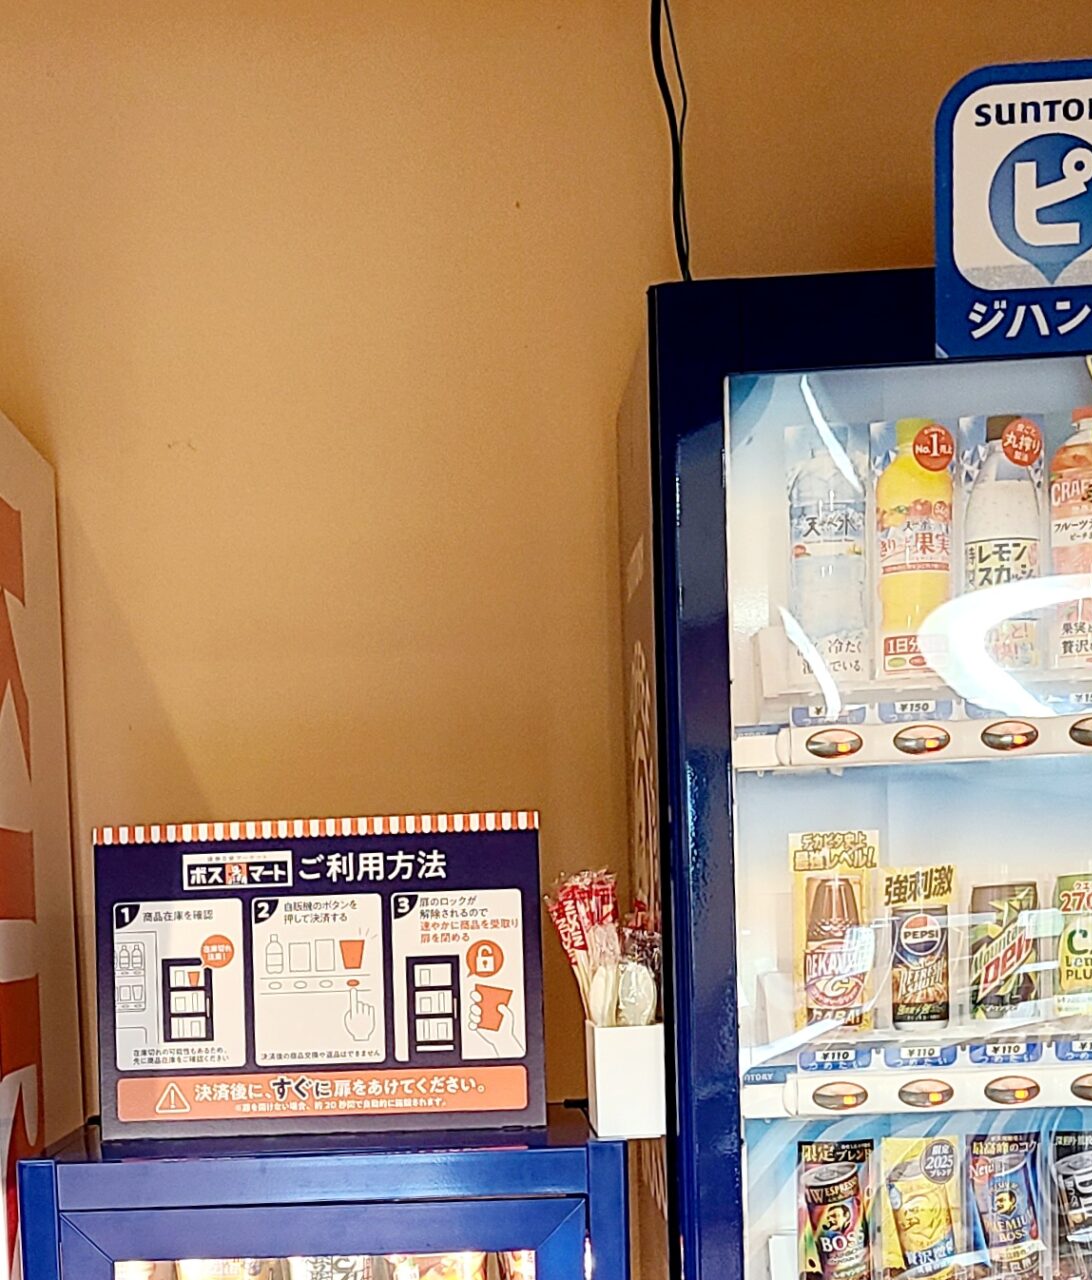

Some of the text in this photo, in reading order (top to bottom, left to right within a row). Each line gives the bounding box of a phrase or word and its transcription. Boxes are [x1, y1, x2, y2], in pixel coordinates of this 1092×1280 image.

[979, 543, 1027, 563] レモン
[189, 849, 447, 885] ボス マート ご利用方法
[884, 865, 952, 906] 強刺激
[257, 901, 357, 919] 2 自販機のボタンを
[396, 896, 476, 913] 3 扉のロックが
[119, 907, 213, 922] 1 商品在庫を確認
[284, 912, 348, 925] 押して決済する
[419, 907, 488, 919] 解除されるので
[420, 919, 519, 932] 速やかに商品を受取り
[420, 932, 470, 943] 扉を閉める
[904, 930, 939, 940] PEPSI
[822, 1051, 849, 1060] ¥110
[908, 1047, 935, 1057] ¥110
[992, 1044, 1020, 1054] ¥110
[926, 1156, 953, 1169] 2025
[970, 1164, 995, 1178] New
[821, 1229, 864, 1252] BOSS
